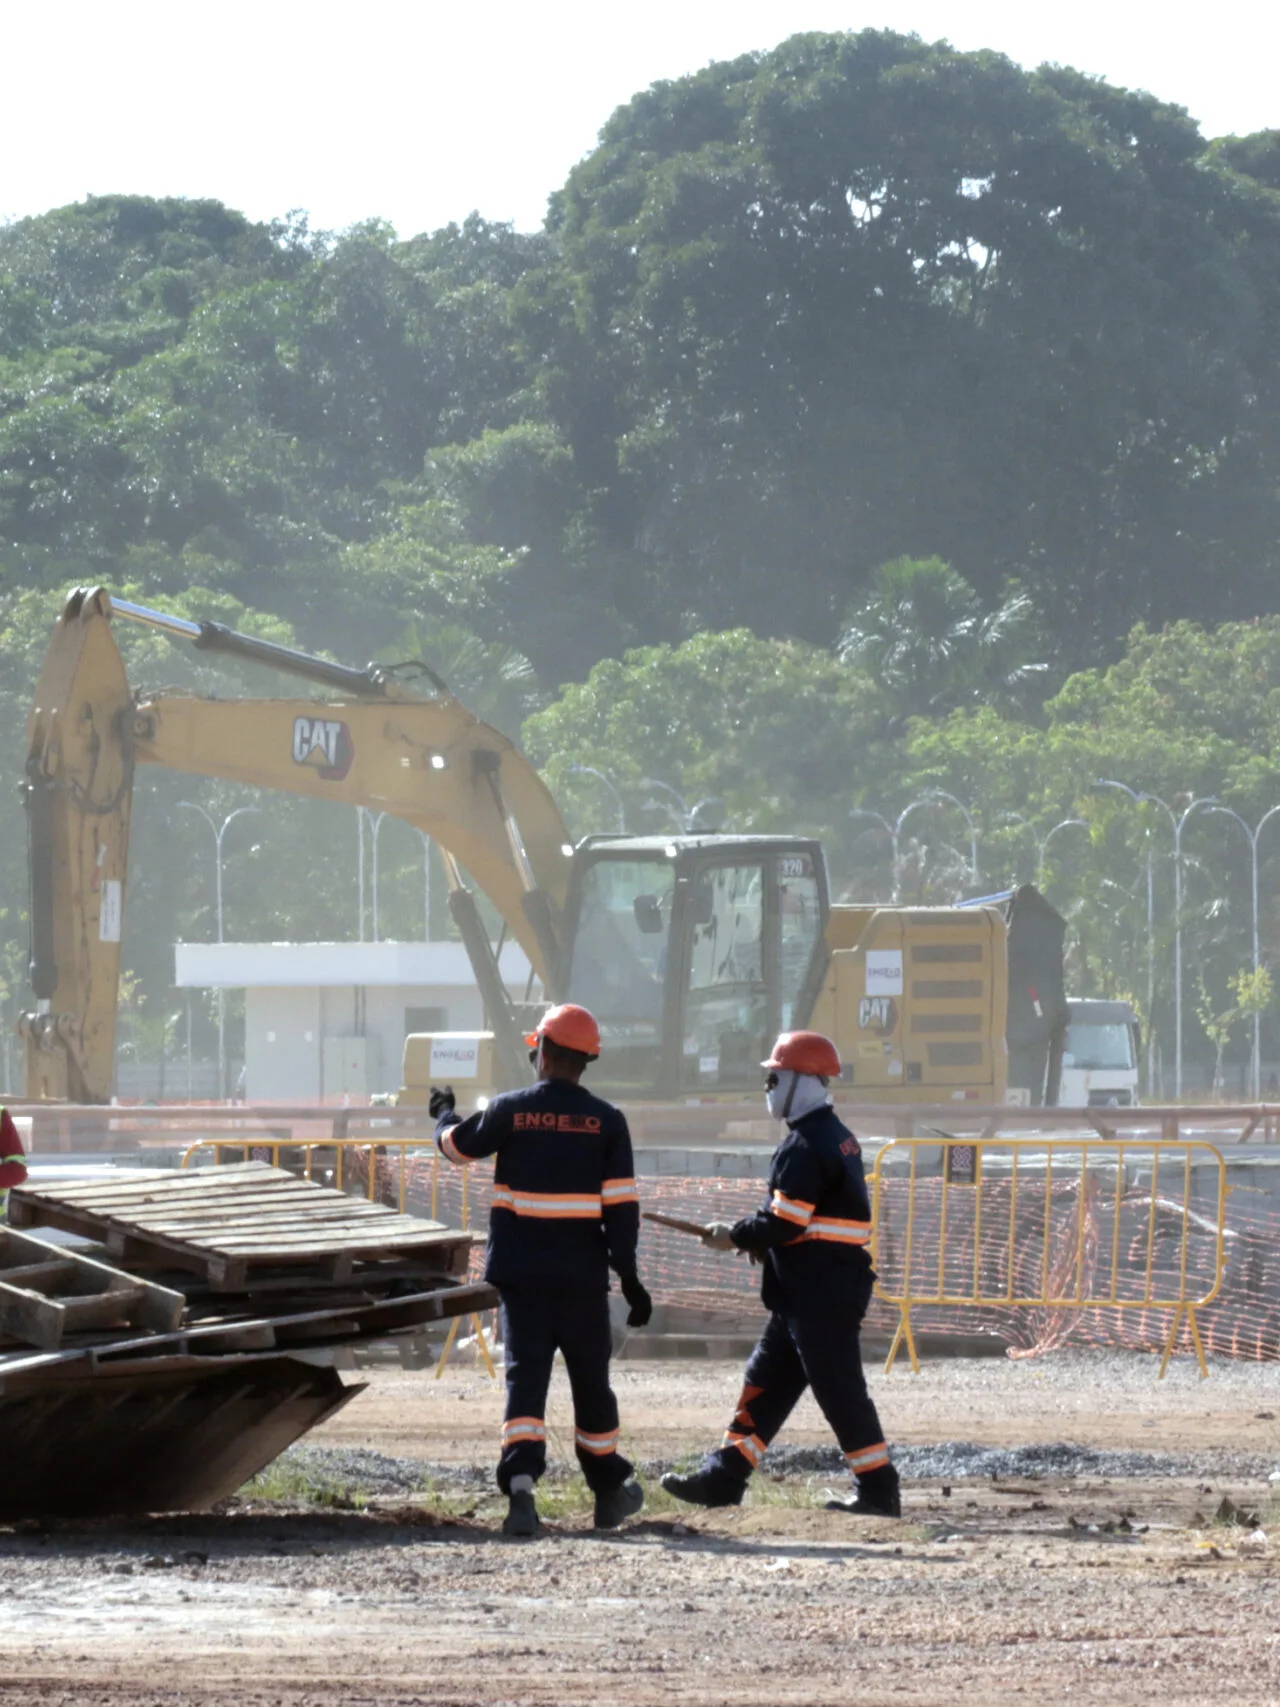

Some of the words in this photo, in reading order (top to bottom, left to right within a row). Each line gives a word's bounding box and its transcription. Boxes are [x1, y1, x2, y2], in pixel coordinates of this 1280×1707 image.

[294, 717, 341, 766] CAT
[782, 859, 803, 877] 320
[858, 998, 890, 1029] CAT
